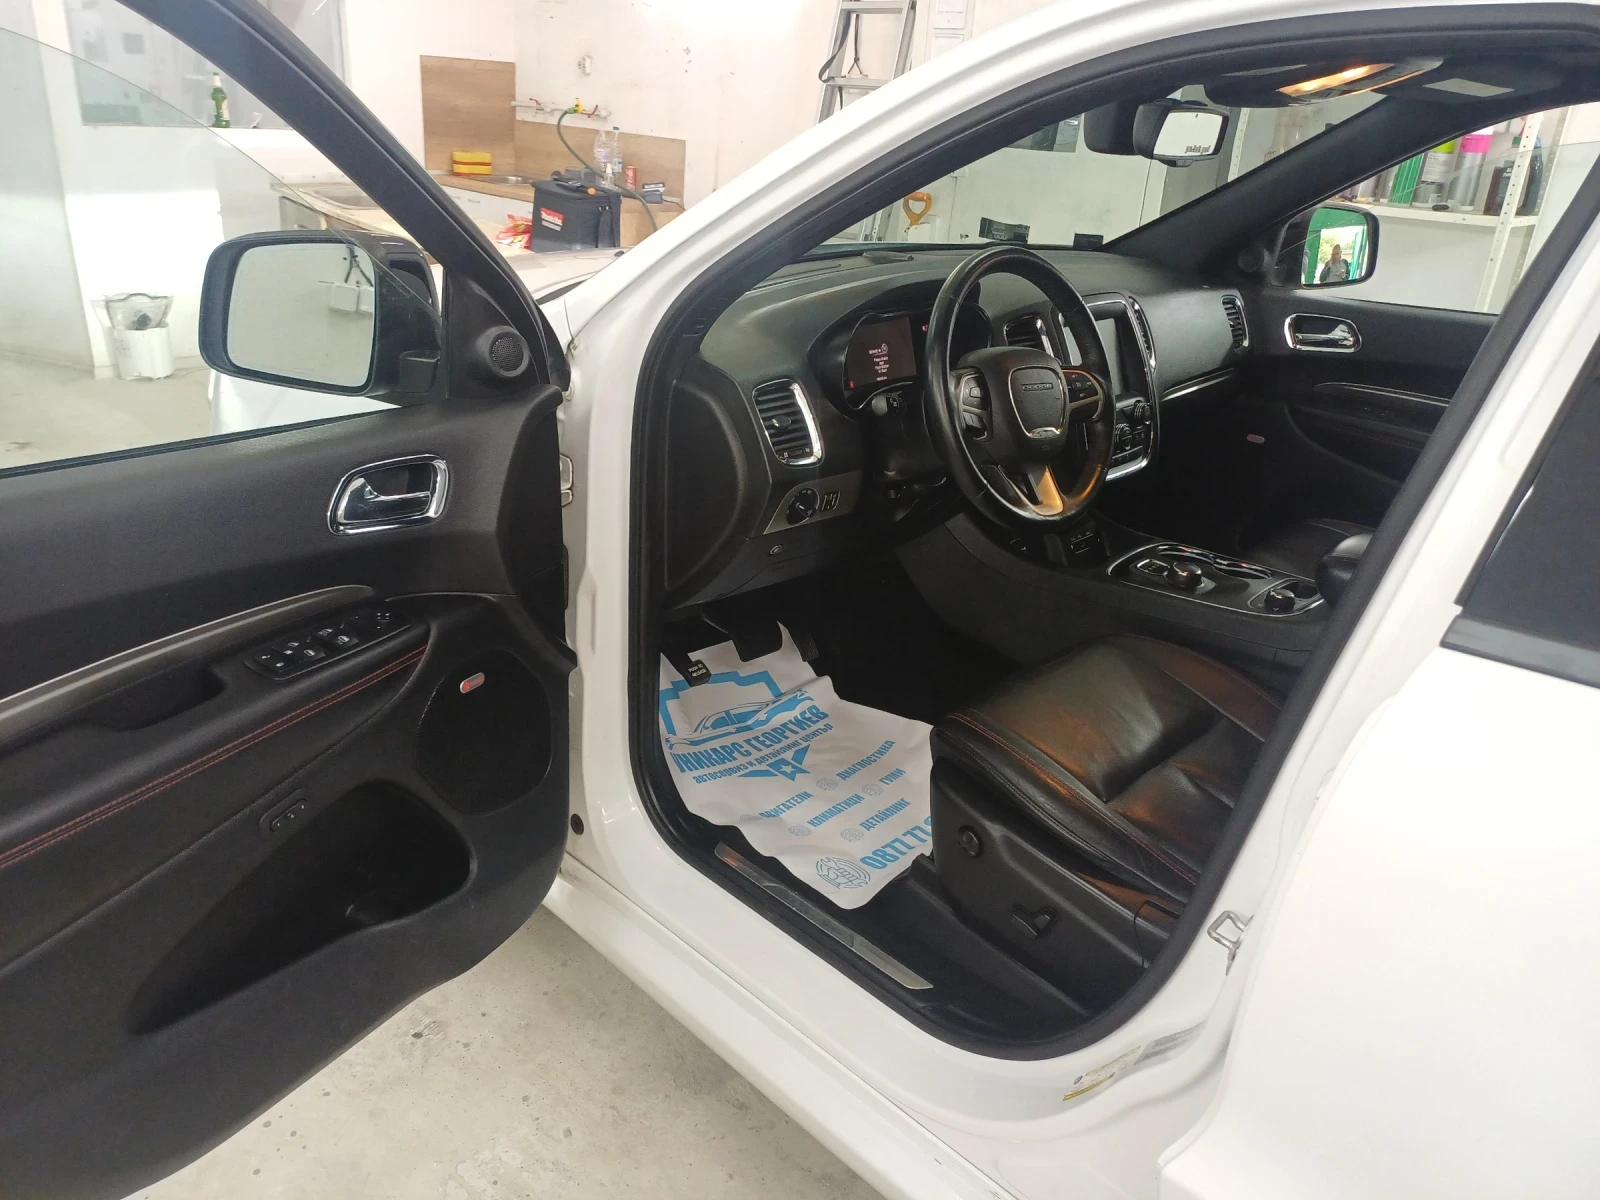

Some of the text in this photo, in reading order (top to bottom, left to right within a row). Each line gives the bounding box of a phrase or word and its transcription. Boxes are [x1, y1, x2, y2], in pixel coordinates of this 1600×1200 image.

[743, 704, 829, 752] ГЕОРГИЕВ
[692, 764, 749, 784] автосервиз
[753, 740, 802, 765] детайлинг
[801, 722, 834, 744] център
[835, 739, 897, 781] ДИАГНОСТИКА
[878, 767, 906, 785] ГУМИ
[807, 793, 866, 828] КЛИМАТИЦИ
[859, 797, 911, 832] ДЕТАЙЛИНГ
[859, 837, 916, 869] 0877
